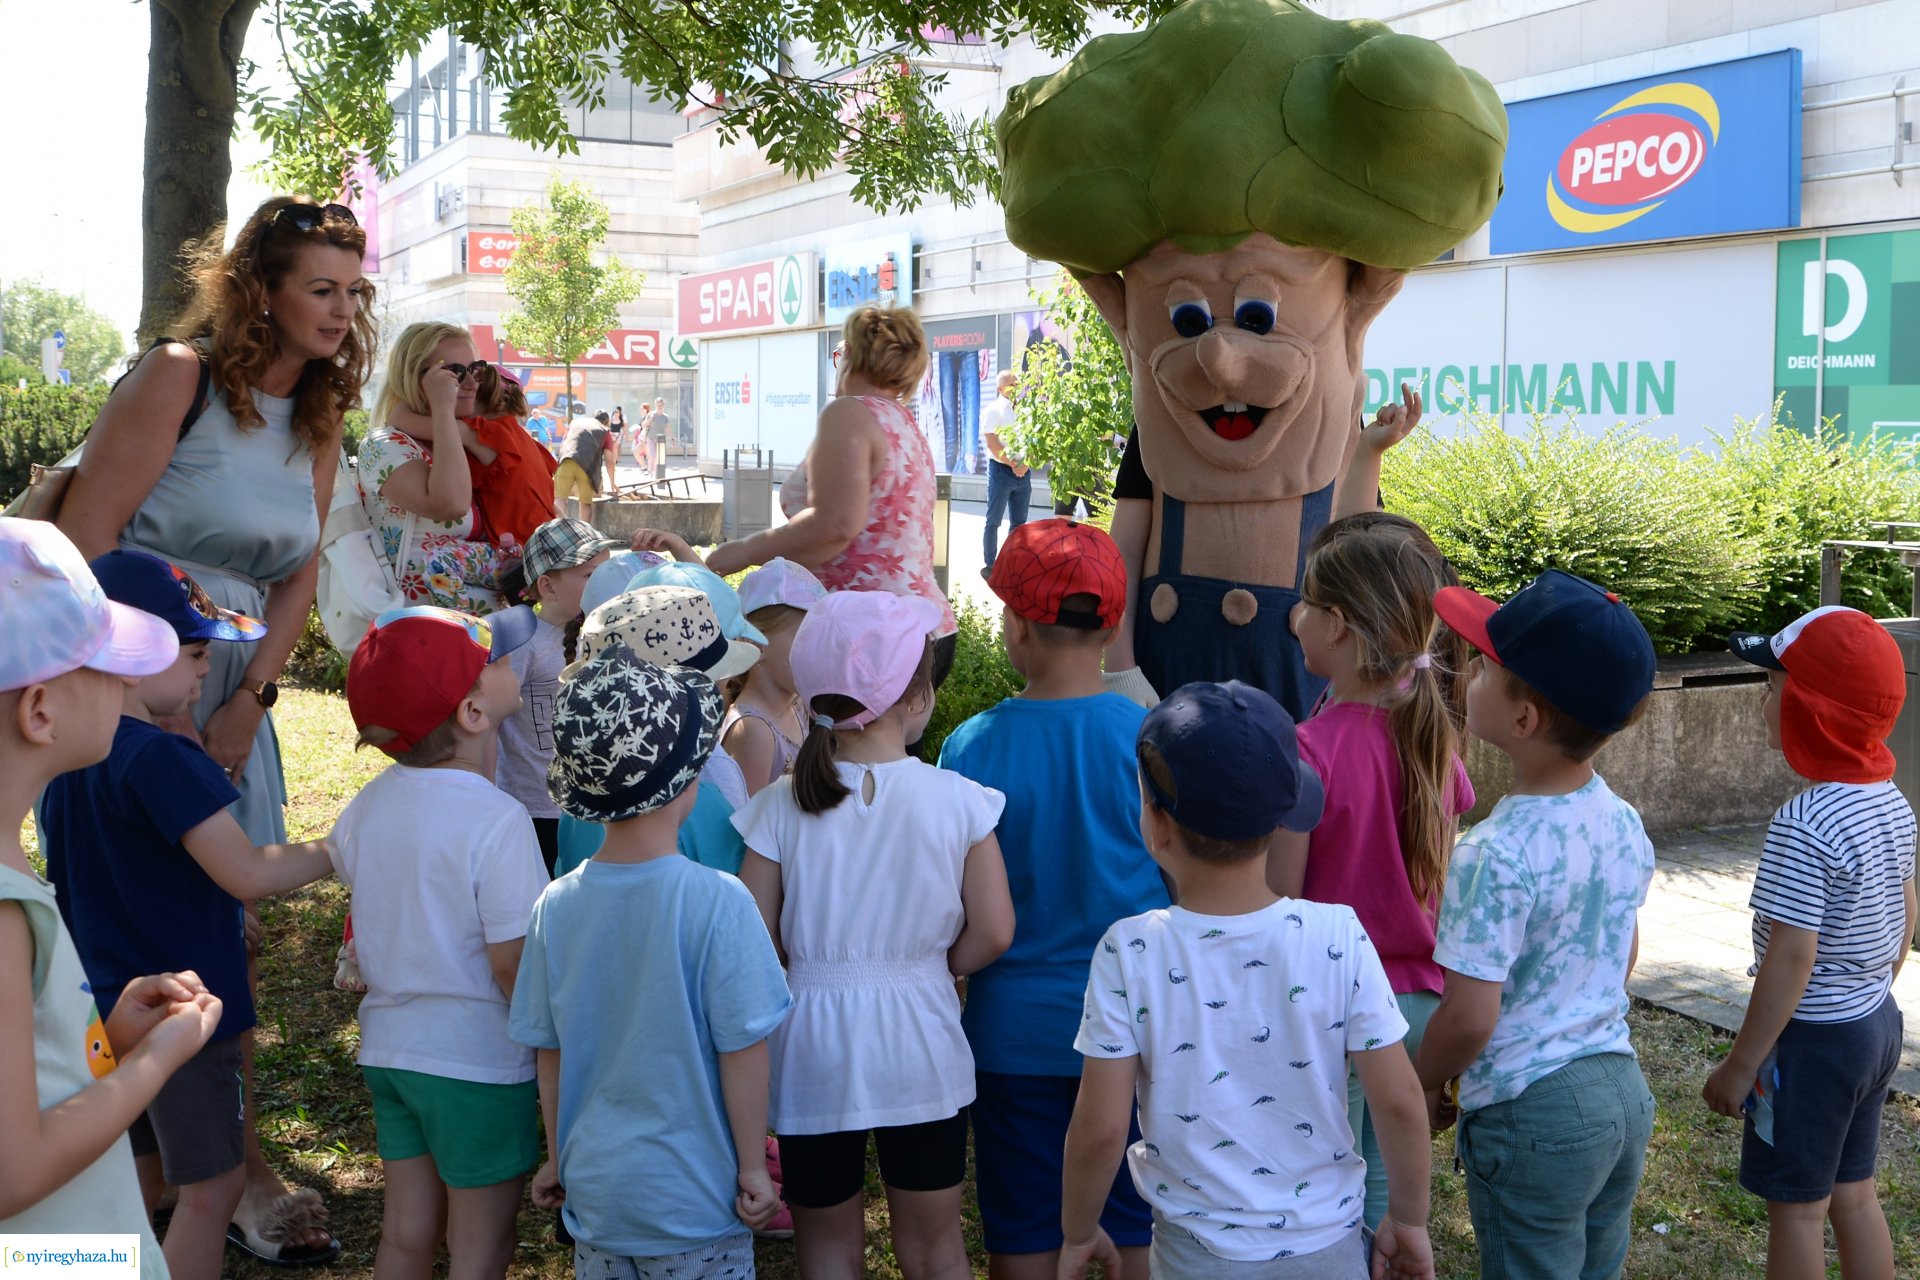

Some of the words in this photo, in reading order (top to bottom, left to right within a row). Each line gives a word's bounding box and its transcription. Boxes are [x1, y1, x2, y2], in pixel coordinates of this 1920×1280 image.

[1571, 131, 1691, 188] PEPCO
[700, 271, 772, 325] SPAR
[1803, 259, 1868, 342] D
[1364, 361, 1675, 415] DEICHMANN
[1787, 354, 1876, 369] DEICHMANN
[715, 382, 740, 404] ERSTE
